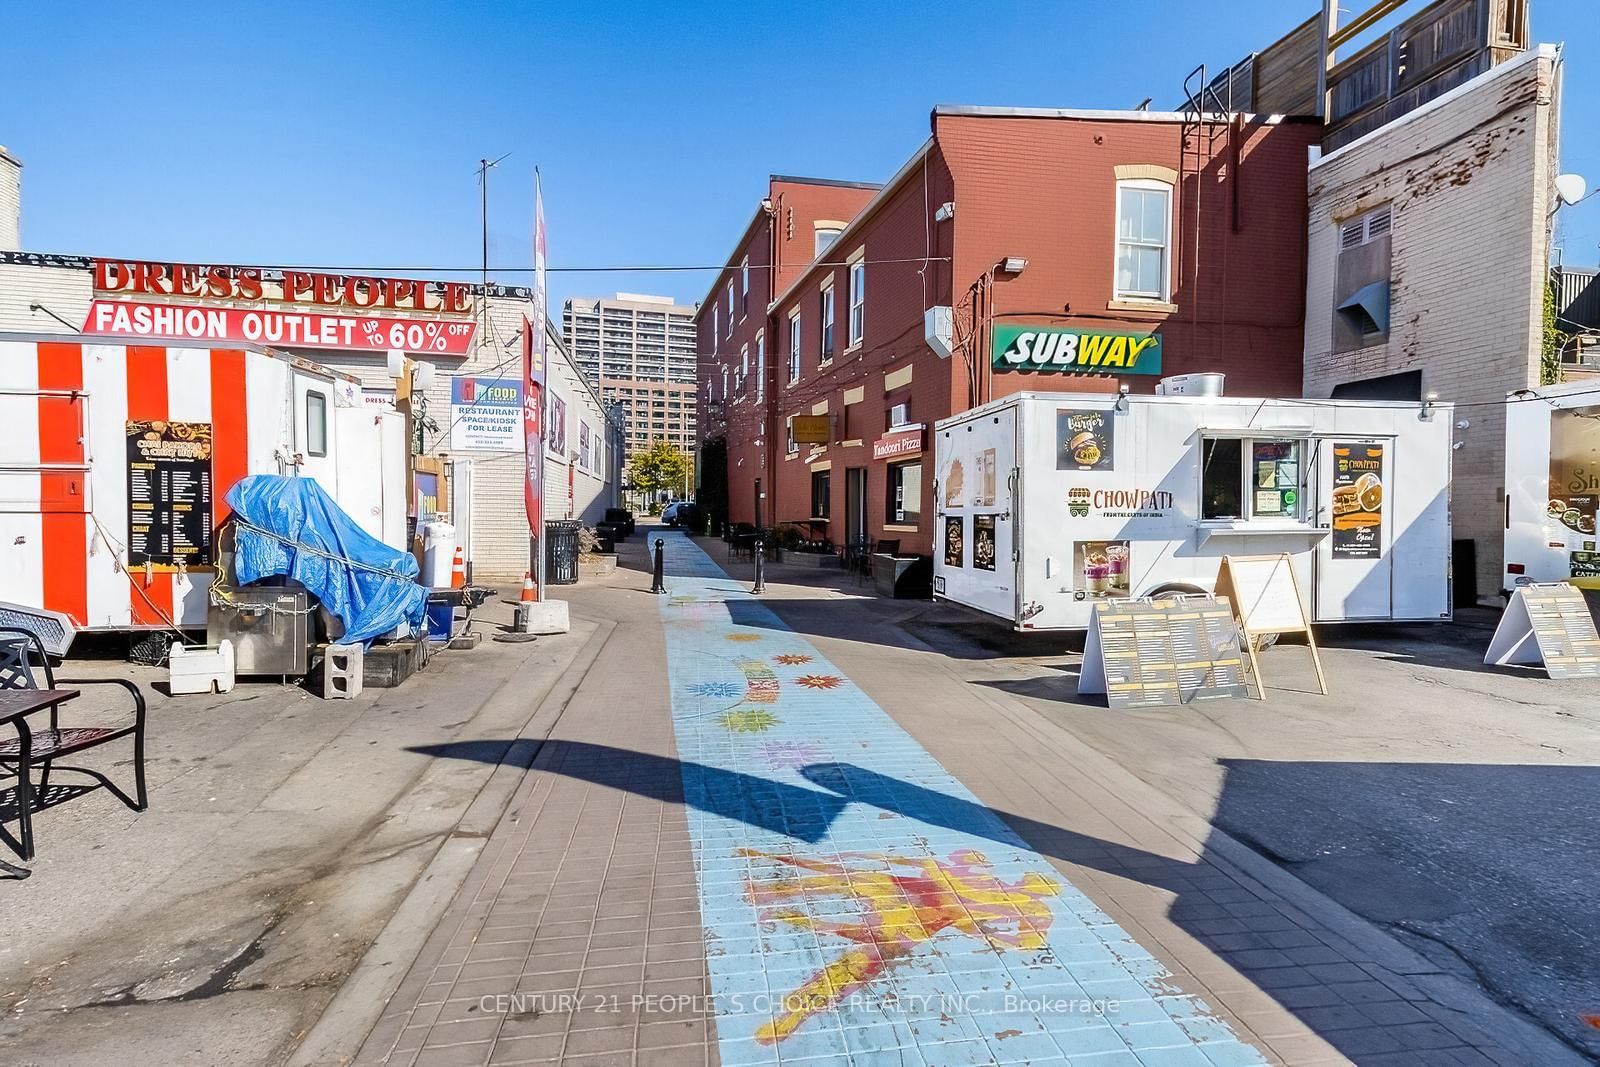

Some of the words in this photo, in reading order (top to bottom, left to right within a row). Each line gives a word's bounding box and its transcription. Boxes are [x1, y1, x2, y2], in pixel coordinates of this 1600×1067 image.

[93, 258, 264, 300] DRESS
[282, 271, 473, 314] PEOPLE
[96, 303, 227, 338] FASHION
[242, 313, 357, 345] OUTLET
[362, 320, 379, 334] UP
[367, 333, 384, 346] TO
[389, 322, 447, 351] 60%
[448, 324, 470, 336] OFF
[1005, 332, 1158, 367] SUBWAY
[458, 407, 521, 416] RESTAURANT
[461, 416, 517, 425] SPACE/KIOSK
[467, 424, 485, 432] FOR
[874, 440, 900, 457] Tandoori
[902, 437, 920, 451] Pizza
